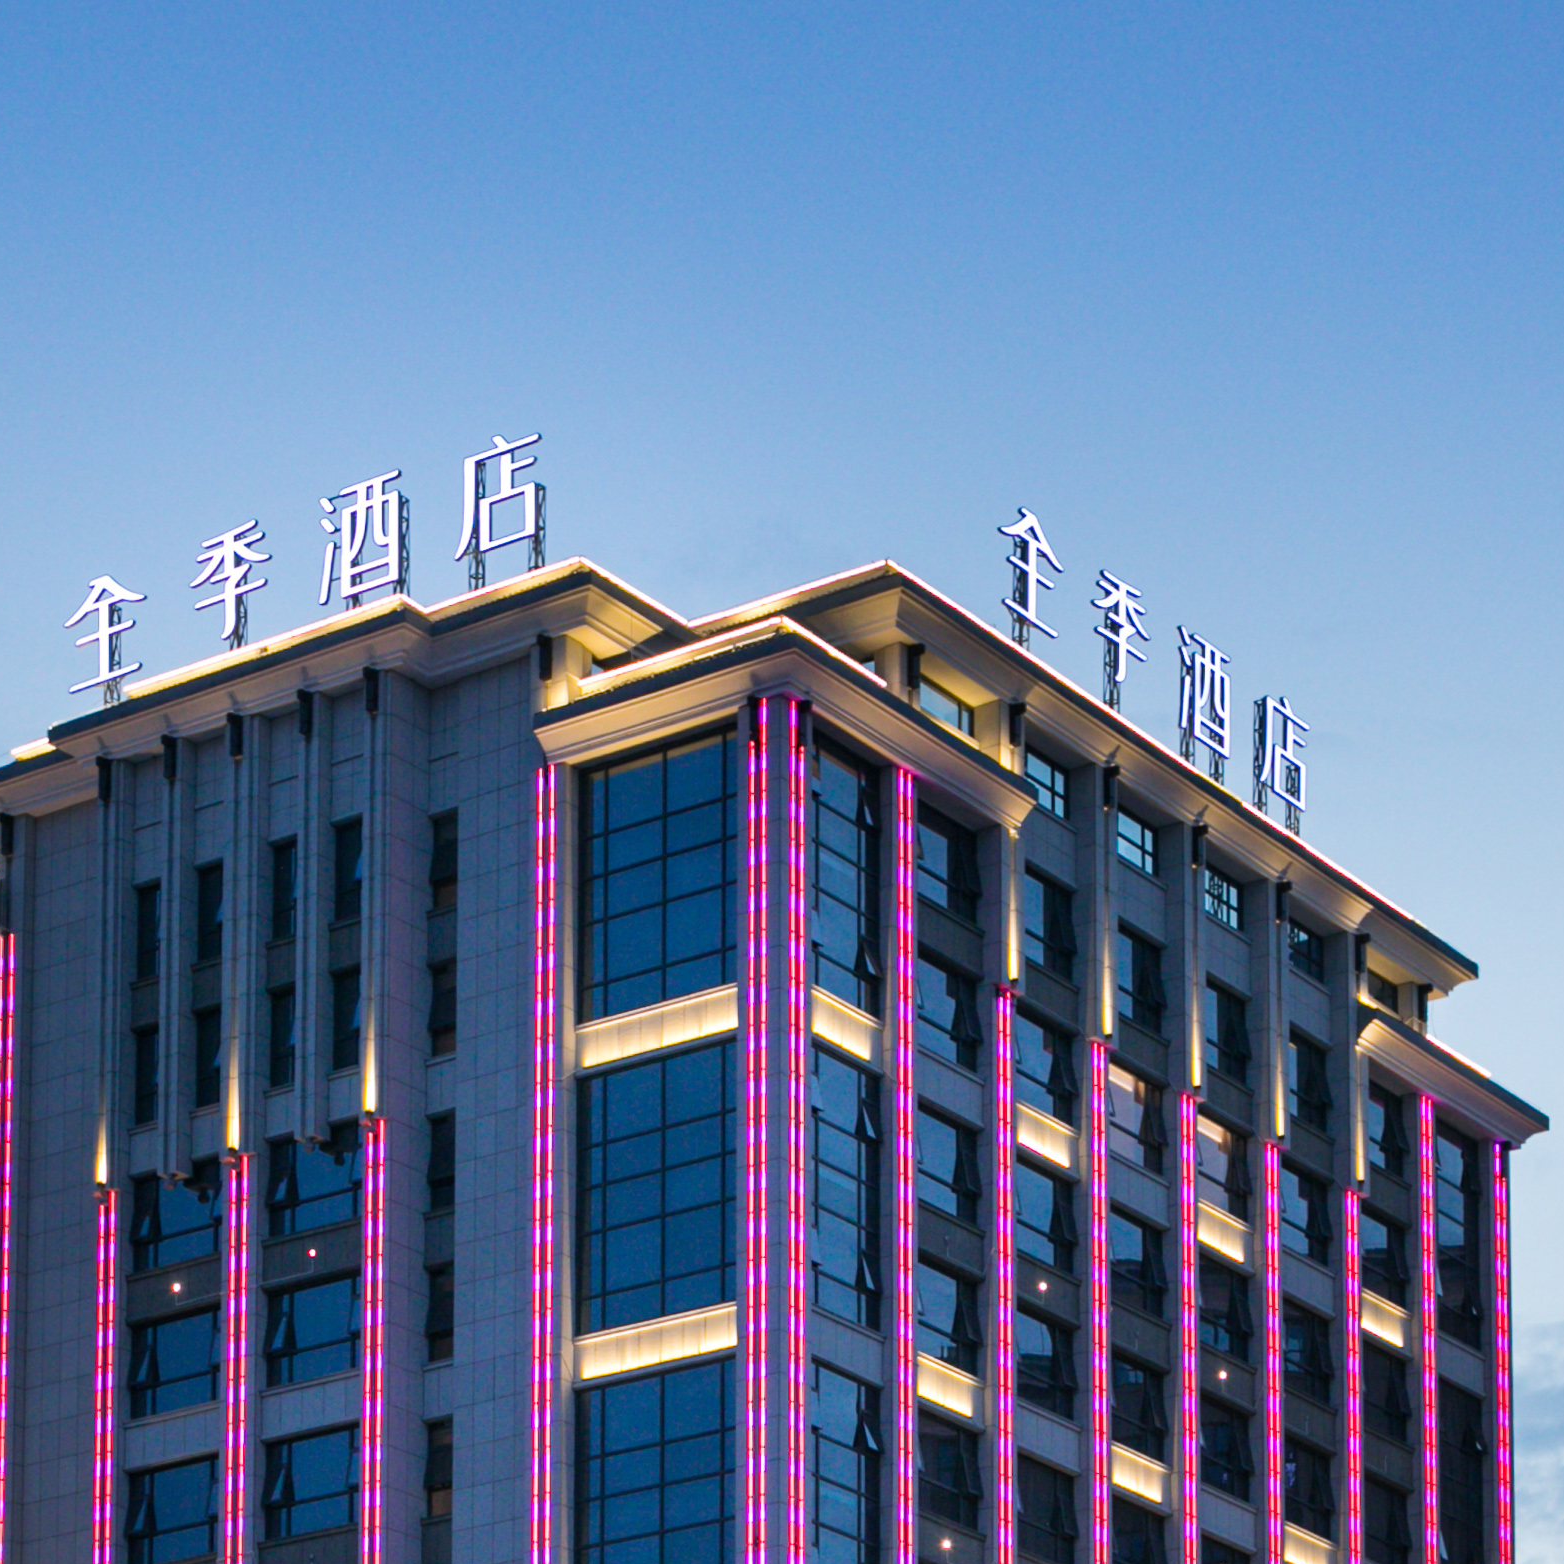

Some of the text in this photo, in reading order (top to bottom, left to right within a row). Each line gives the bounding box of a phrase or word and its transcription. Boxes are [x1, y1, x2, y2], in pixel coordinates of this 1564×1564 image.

[64, 433, 542, 695] 全季酒店
[998, 507, 1310, 812] 全季酒店
